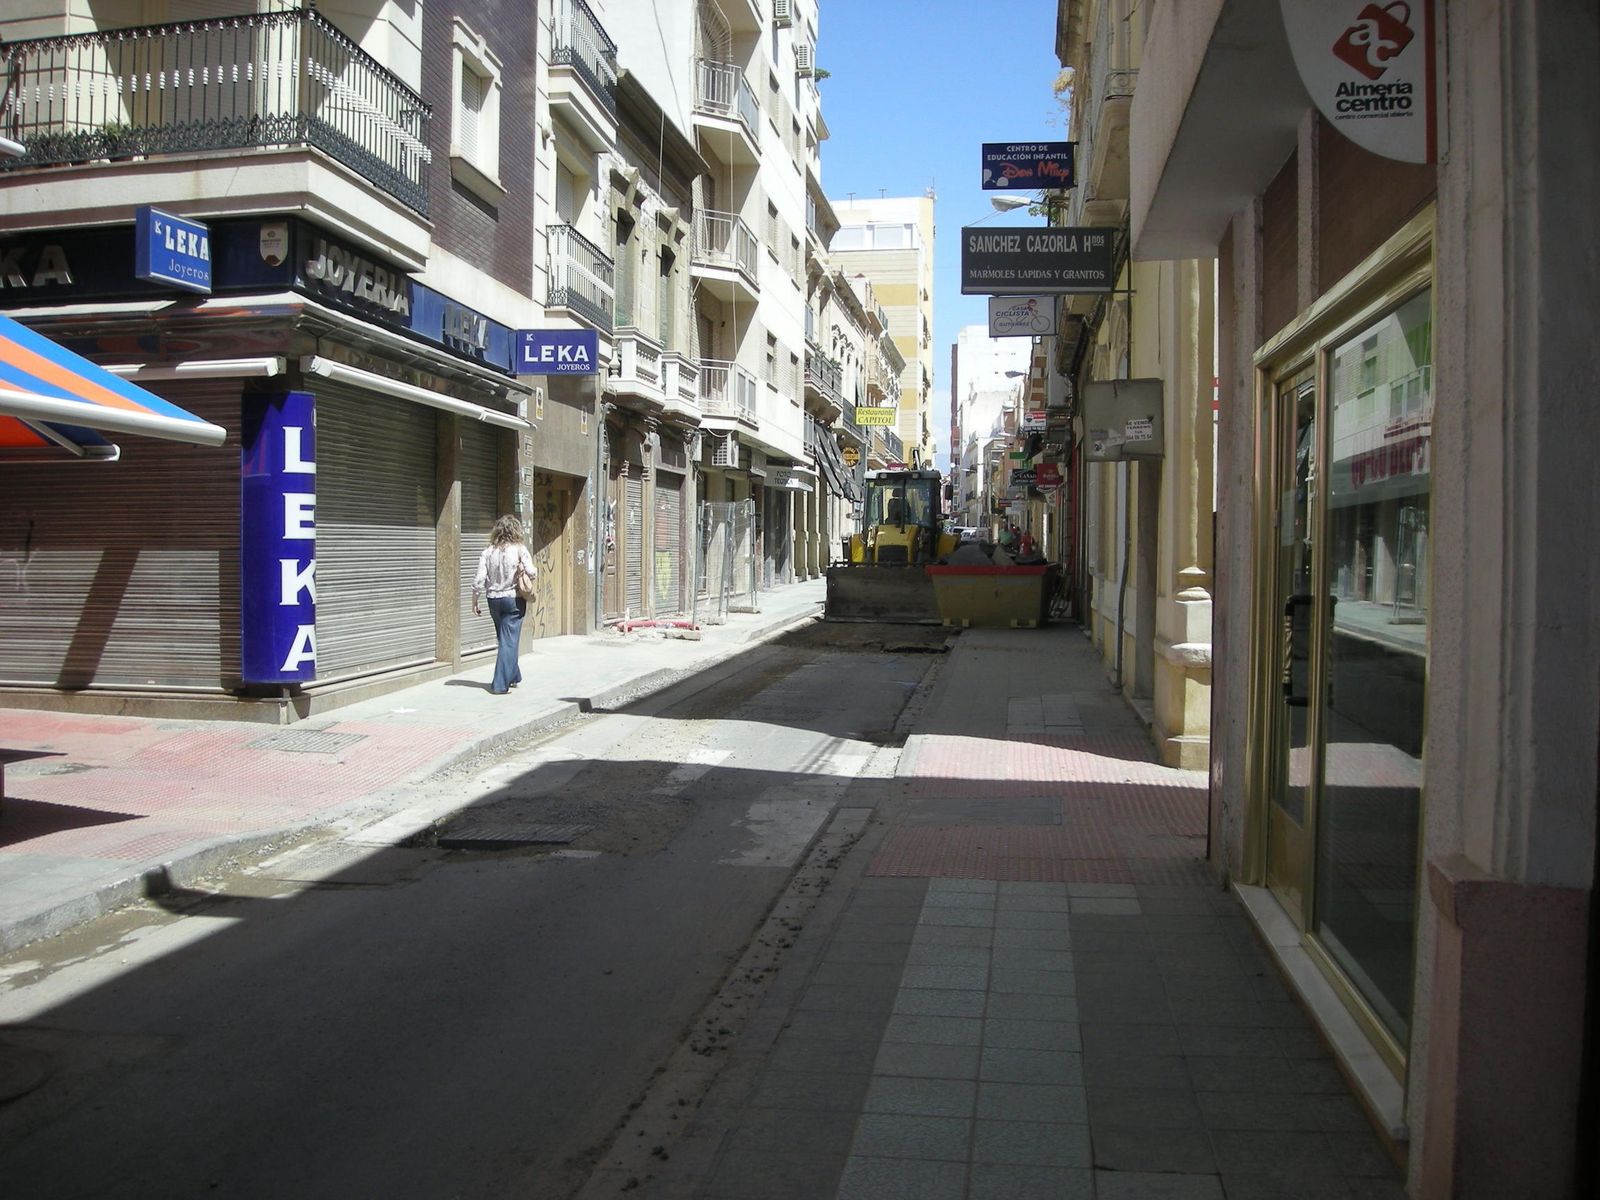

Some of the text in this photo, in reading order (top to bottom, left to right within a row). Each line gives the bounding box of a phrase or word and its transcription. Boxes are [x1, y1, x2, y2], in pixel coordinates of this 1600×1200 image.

[1335, 78, 1413, 97] Almería
[1336, 94, 1412, 112] centro
[987, 153, 1031, 161] EDUCACIÓN
[165, 225, 209, 261] LEKA
[969, 235, 1021, 253] SANCHEZ
[1026, 235, 1078, 253] CAZORLA
[168, 258, 209, 282] Joyeros
[305, 239, 410, 317] JOYERIA
[1054, 269, 1060, 279] Y
[1062, 269, 1105, 280] GRANITOS
[524, 345, 589, 362] LEKA
[556, 363, 590, 371] JOYEROS
[278, 426, 317, 672] LEKA
